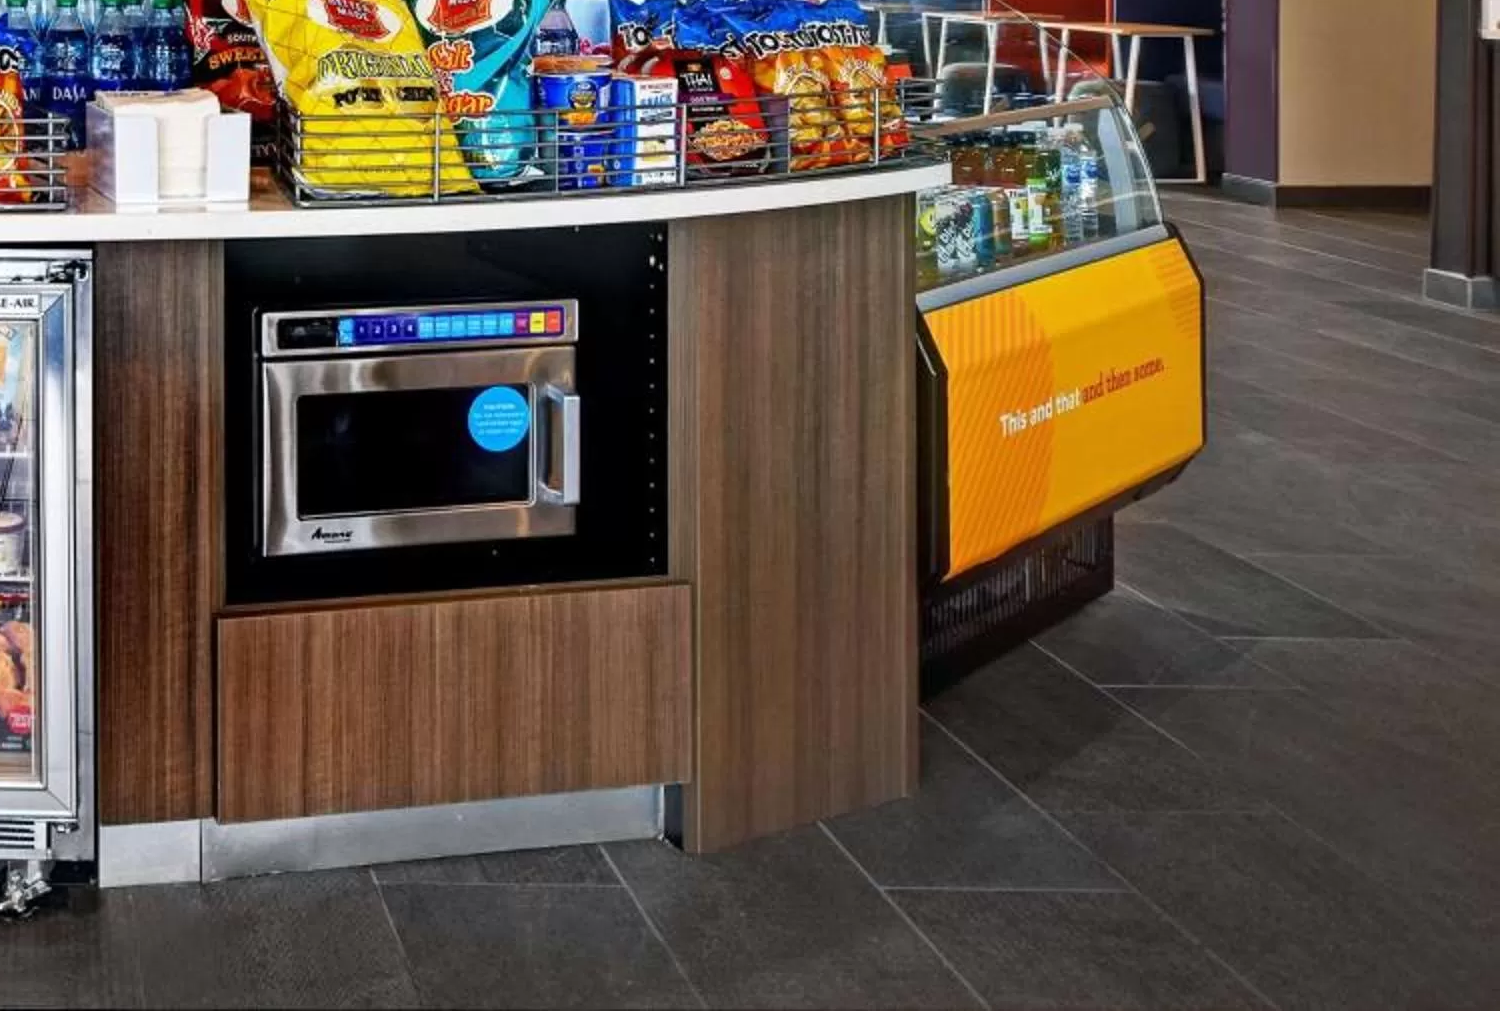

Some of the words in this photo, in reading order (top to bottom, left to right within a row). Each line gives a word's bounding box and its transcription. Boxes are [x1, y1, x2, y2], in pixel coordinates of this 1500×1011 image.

[52, 84, 87, 103] DASA
[999, 409, 1028, 438] This
[1030, 397, 1053, 426] and
[1056, 387, 1081, 415] that
[1082, 373, 1104, 404] and
[1106, 367, 1132, 393] then
